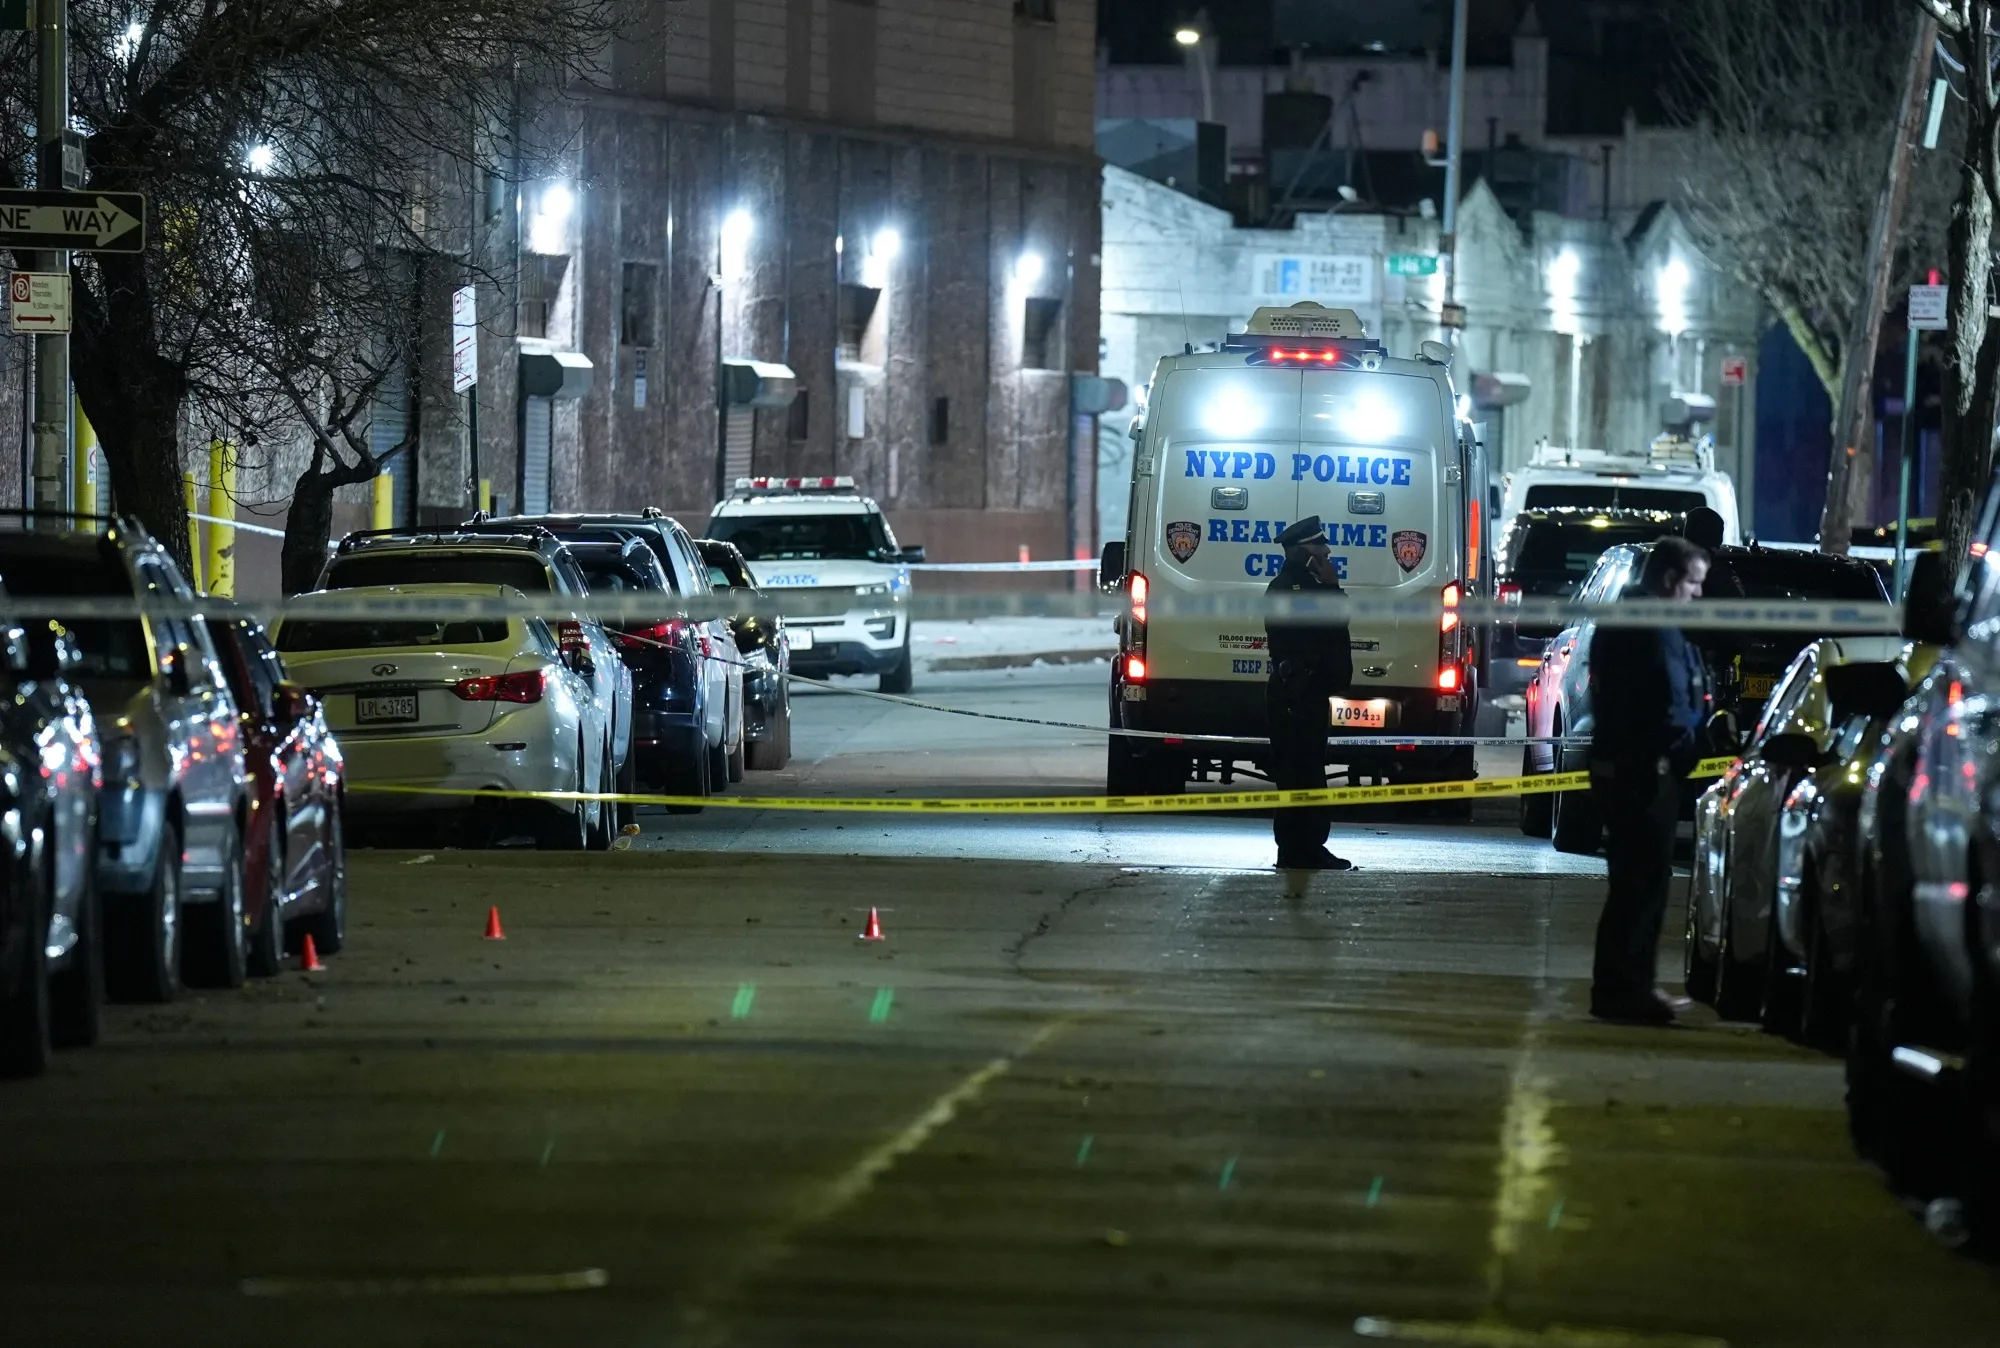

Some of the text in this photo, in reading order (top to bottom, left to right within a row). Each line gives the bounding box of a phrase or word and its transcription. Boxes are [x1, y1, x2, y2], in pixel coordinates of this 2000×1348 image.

[0, 208, 119, 232] NE WAY
[1185, 450, 1411, 486] NYPD POLICE
[1208, 519, 1387, 547] REAL IME
[1245, 553, 1348, 579] CRE
[766, 575, 817, 585] POLICE
[1218, 634, 1244, 642] $10,000
[1232, 659, 1262, 673] KEEP
[1336, 707, 1369, 720] 7094
